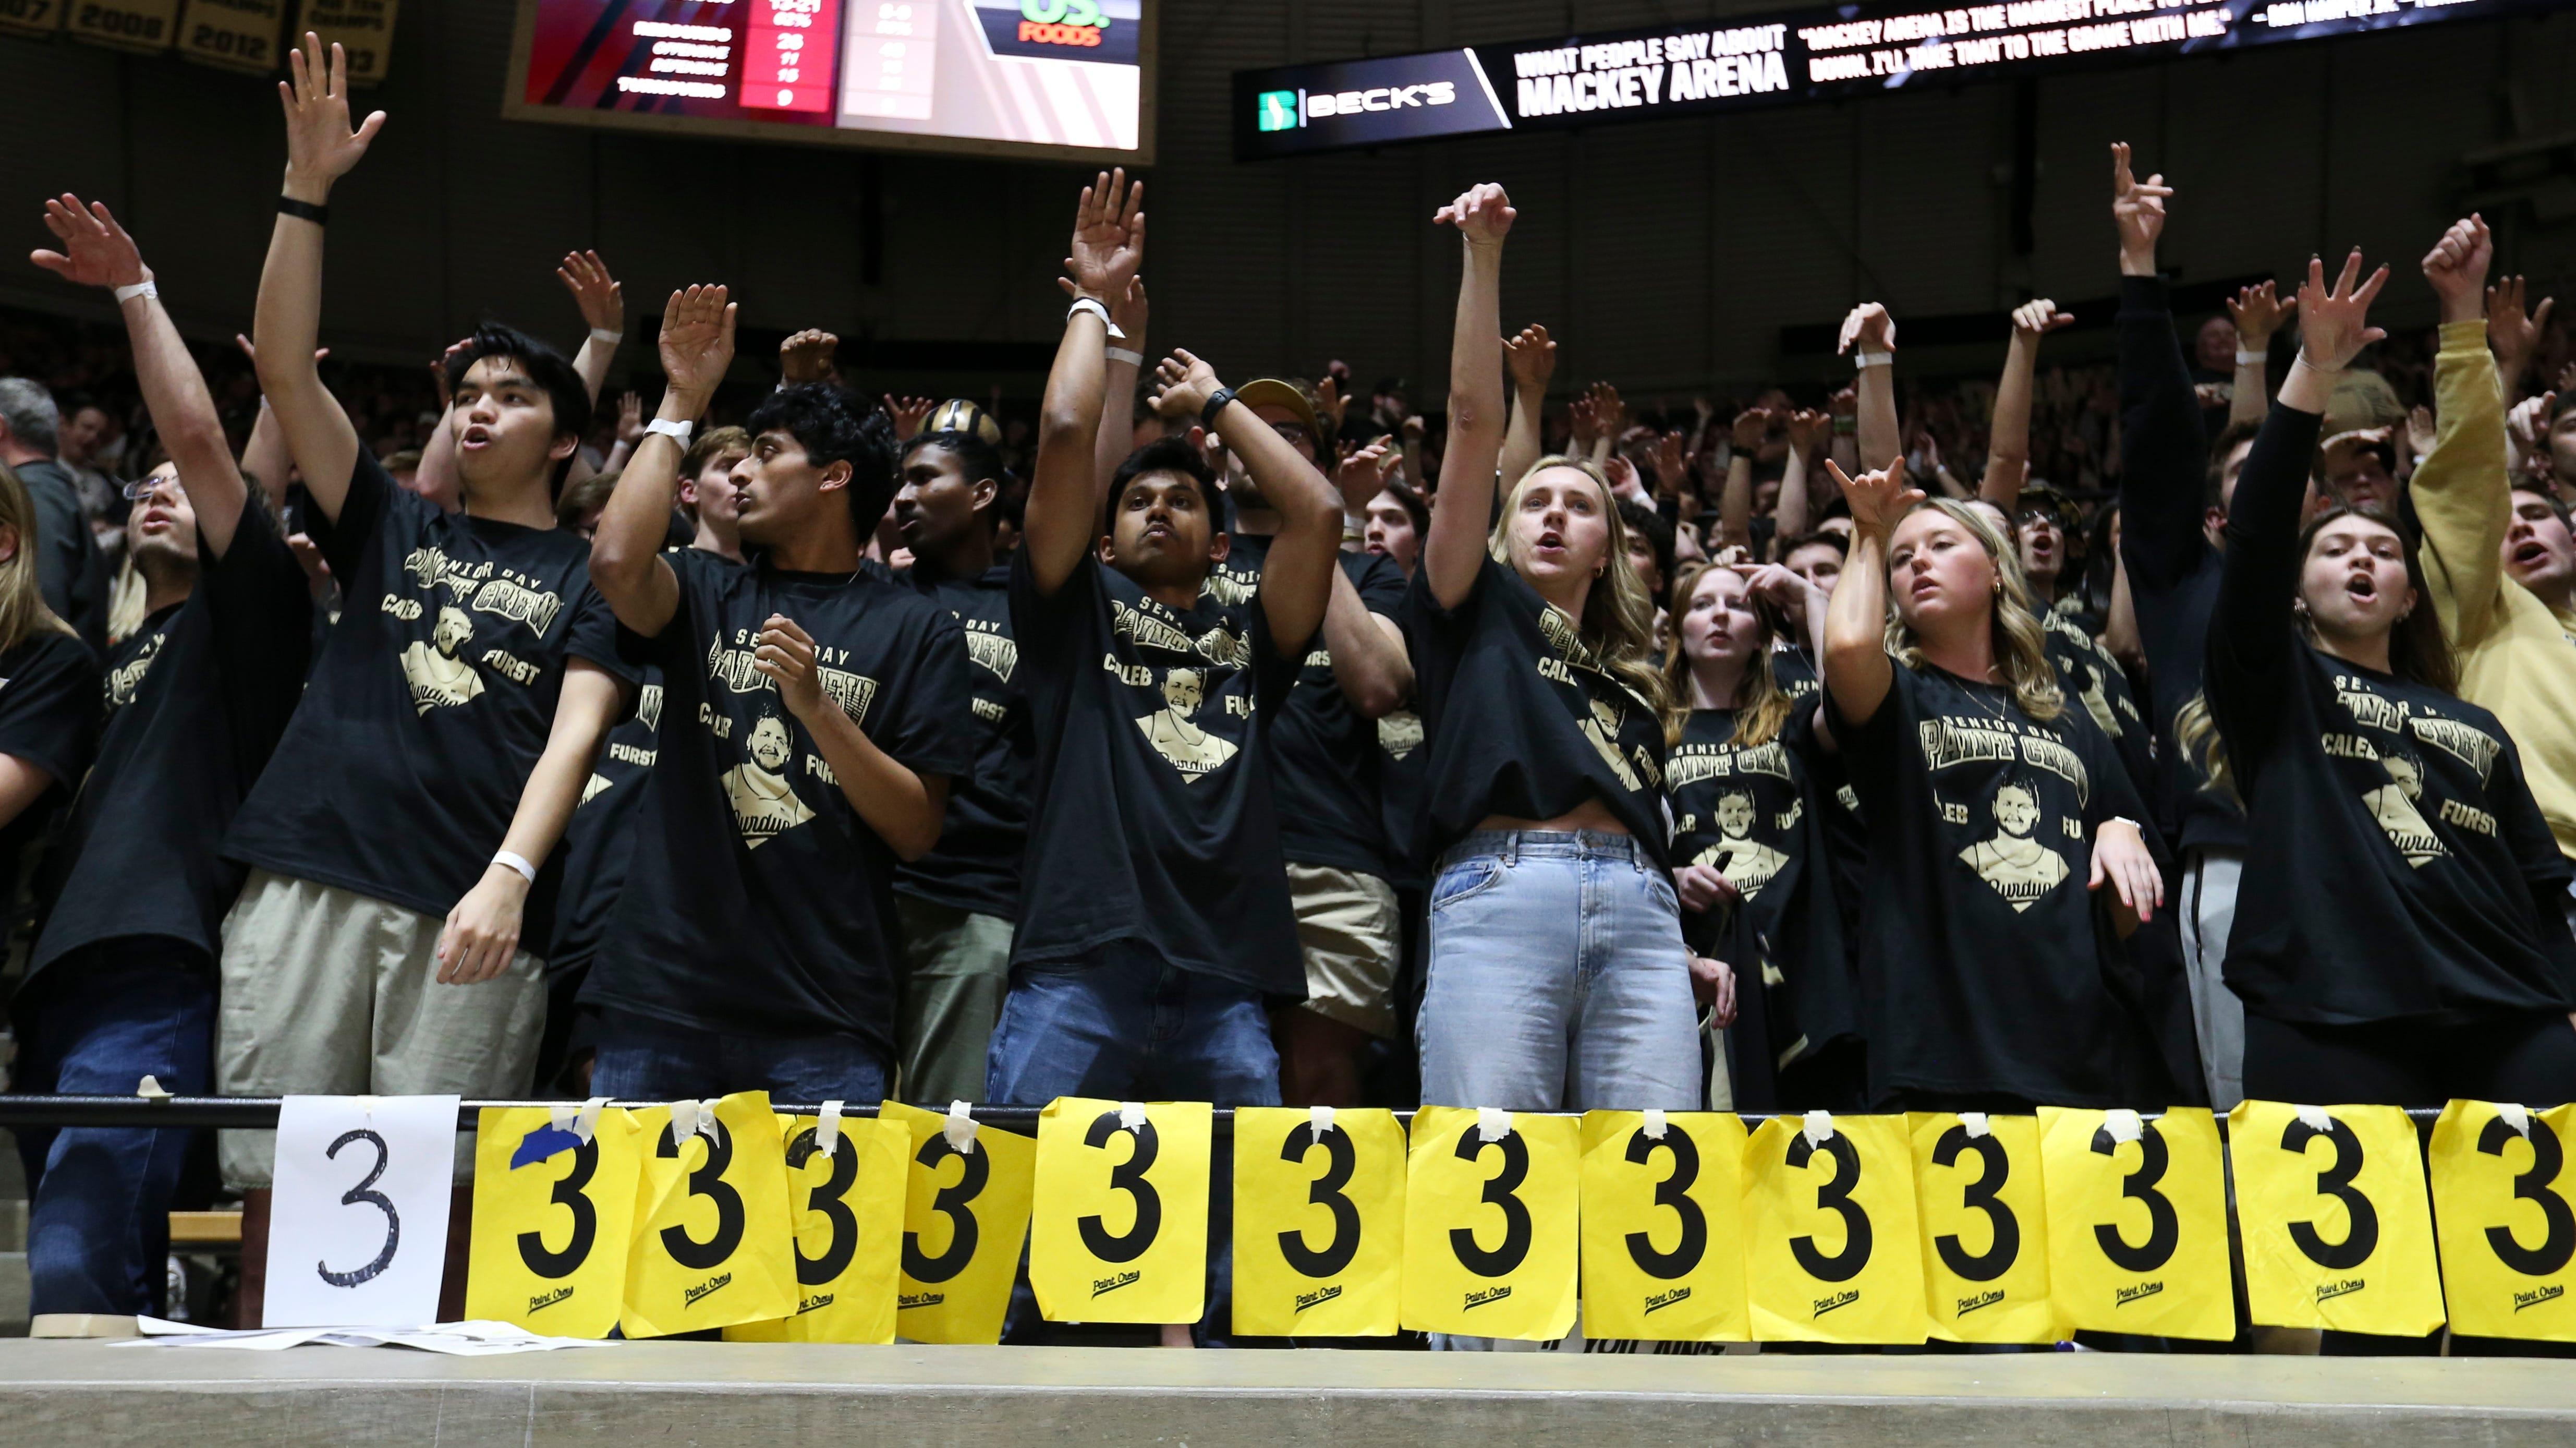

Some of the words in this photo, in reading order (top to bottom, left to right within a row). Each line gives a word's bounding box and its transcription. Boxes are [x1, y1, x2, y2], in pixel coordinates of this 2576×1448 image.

[80, 5, 163, 39] 2008
[193, 23, 268, 60] 2012
[1018, 20, 1102, 47] FOODS
[1884, 13, 1945, 42] ARENA
[1944, 10, 1969, 34] IS
[1969, 6, 2006, 31] THE
[1906, 43, 1954, 70] TAKE
[1953, 38, 2001, 65] THAT
[2001, 35, 2028, 59] TO
[2028, 30, 2067, 56] THE
[2068, 22, 2130, 51] GRAVE
[2130, 16, 2185, 44] WITH
[1515, 47, 1578, 78] WHAT
[1582, 39, 1663, 70] PEOPLE
[1665, 33, 1709, 61] SAY
[1711, 24, 1786, 56] ABOUT
[1307, 81, 1455, 117] BECK'S
[1518, 65, 1664, 116] MACKEY
[1670, 52, 1789, 101] ARENA
[447, 559, 494, 579] NIOR
[1218, 563, 1260, 583] SENI
[381, 593, 423, 620] CAEB
[471, 579, 561, 640] CREW
[966, 619, 1001, 632] DAY
[481, 649, 541, 686] FURST
[708, 629, 777, 694] AIN
[817, 666, 878, 727] EW
[965, 631, 1018, 684] REW
[1537, 656, 1577, 687] CAL
[972, 697, 1007, 723] RST
[1942, 715, 2020, 734] SENIOR
[2027, 725, 2063, 743] DAY
[806, 754, 839, 786] FUR
[1665, 754, 1733, 794] AINT
[1736, 741, 1794, 784] CRE
[1919, 719, 2016, 771] PAINT
[318, 1129, 399, 1288] 3
[517, 1122, 599, 1278] 3
[657, 1116, 745, 1269] 3
[786, 1127, 858, 1285] 3
[902, 1131, 989, 1284] 3
[1078, 1110, 1161, 1263] 3
[1278, 1120, 1361, 1277] 3
[1449, 1123, 1532, 1277] 3
[1625, 1123, 1707, 1279] 3
[1785, 1127, 1873, 1282] 3
[1932, 1124, 2020, 1282] 3
[2091, 1122, 2179, 1272] 3
[2281, 1114, 2379, 1269] 3
[2477, 1114, 2576, 1276] 3
